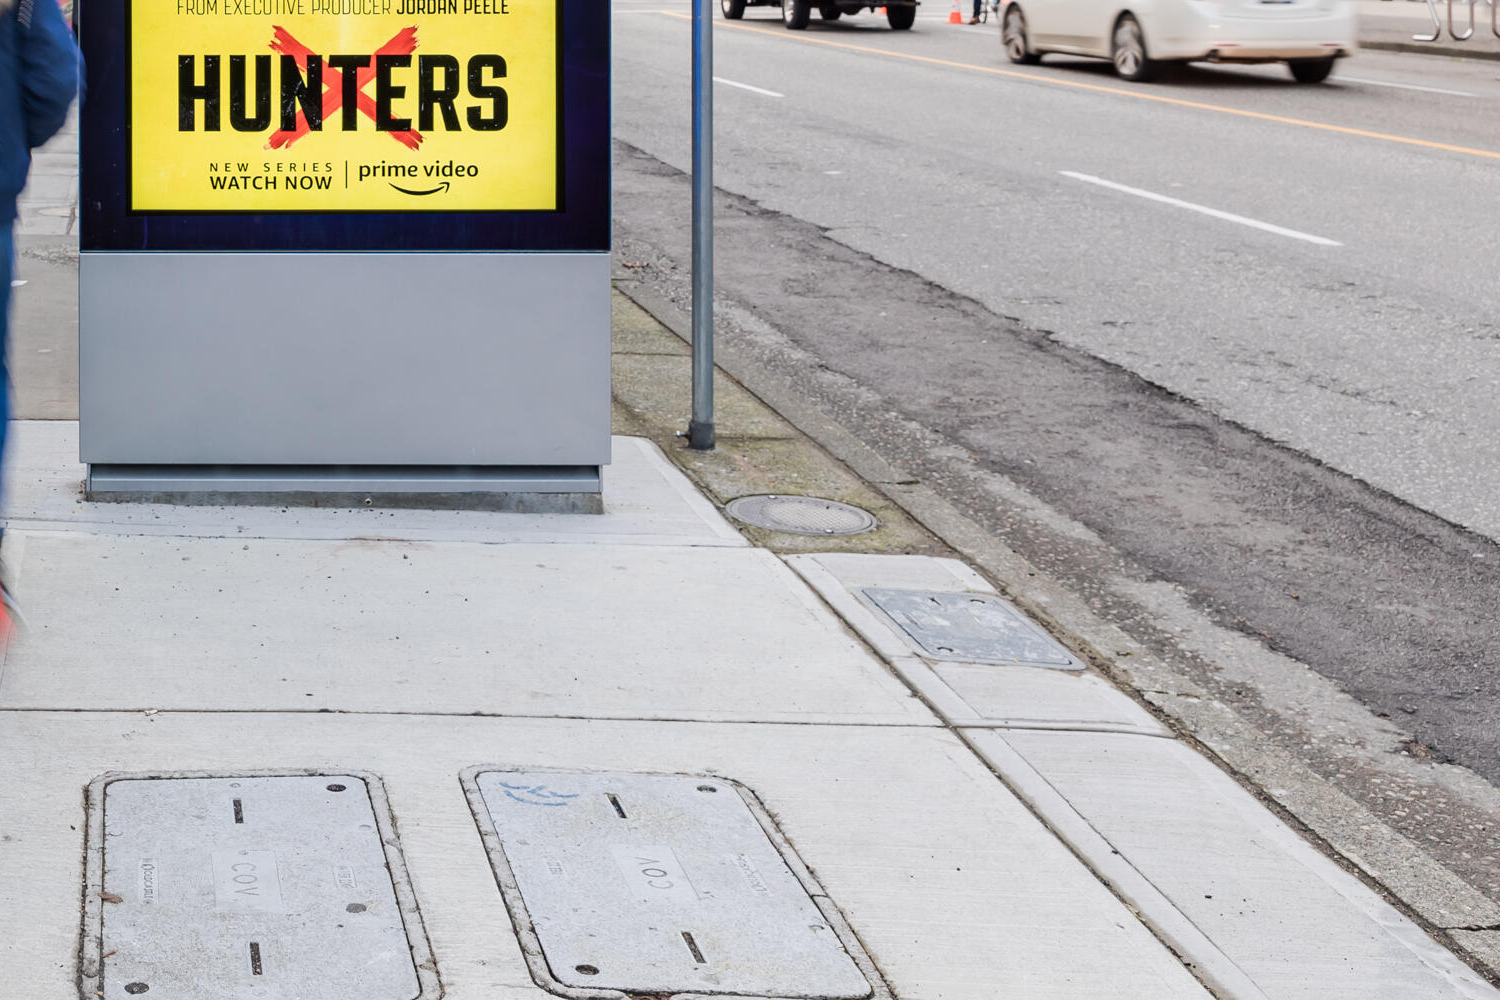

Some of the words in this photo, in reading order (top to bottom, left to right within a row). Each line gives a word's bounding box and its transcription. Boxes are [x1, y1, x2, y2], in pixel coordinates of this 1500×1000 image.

[178, 54, 508, 132] HUNTERS
[209, 162, 249, 172] NEW
[263, 162, 332, 172] SERIES
[359, 160, 418, 181] prime
[423, 160, 479, 178] video
[209, 175, 277, 190] WATCH
[285, 175, 332, 190] NOW
[231, 863, 261, 896] COV
